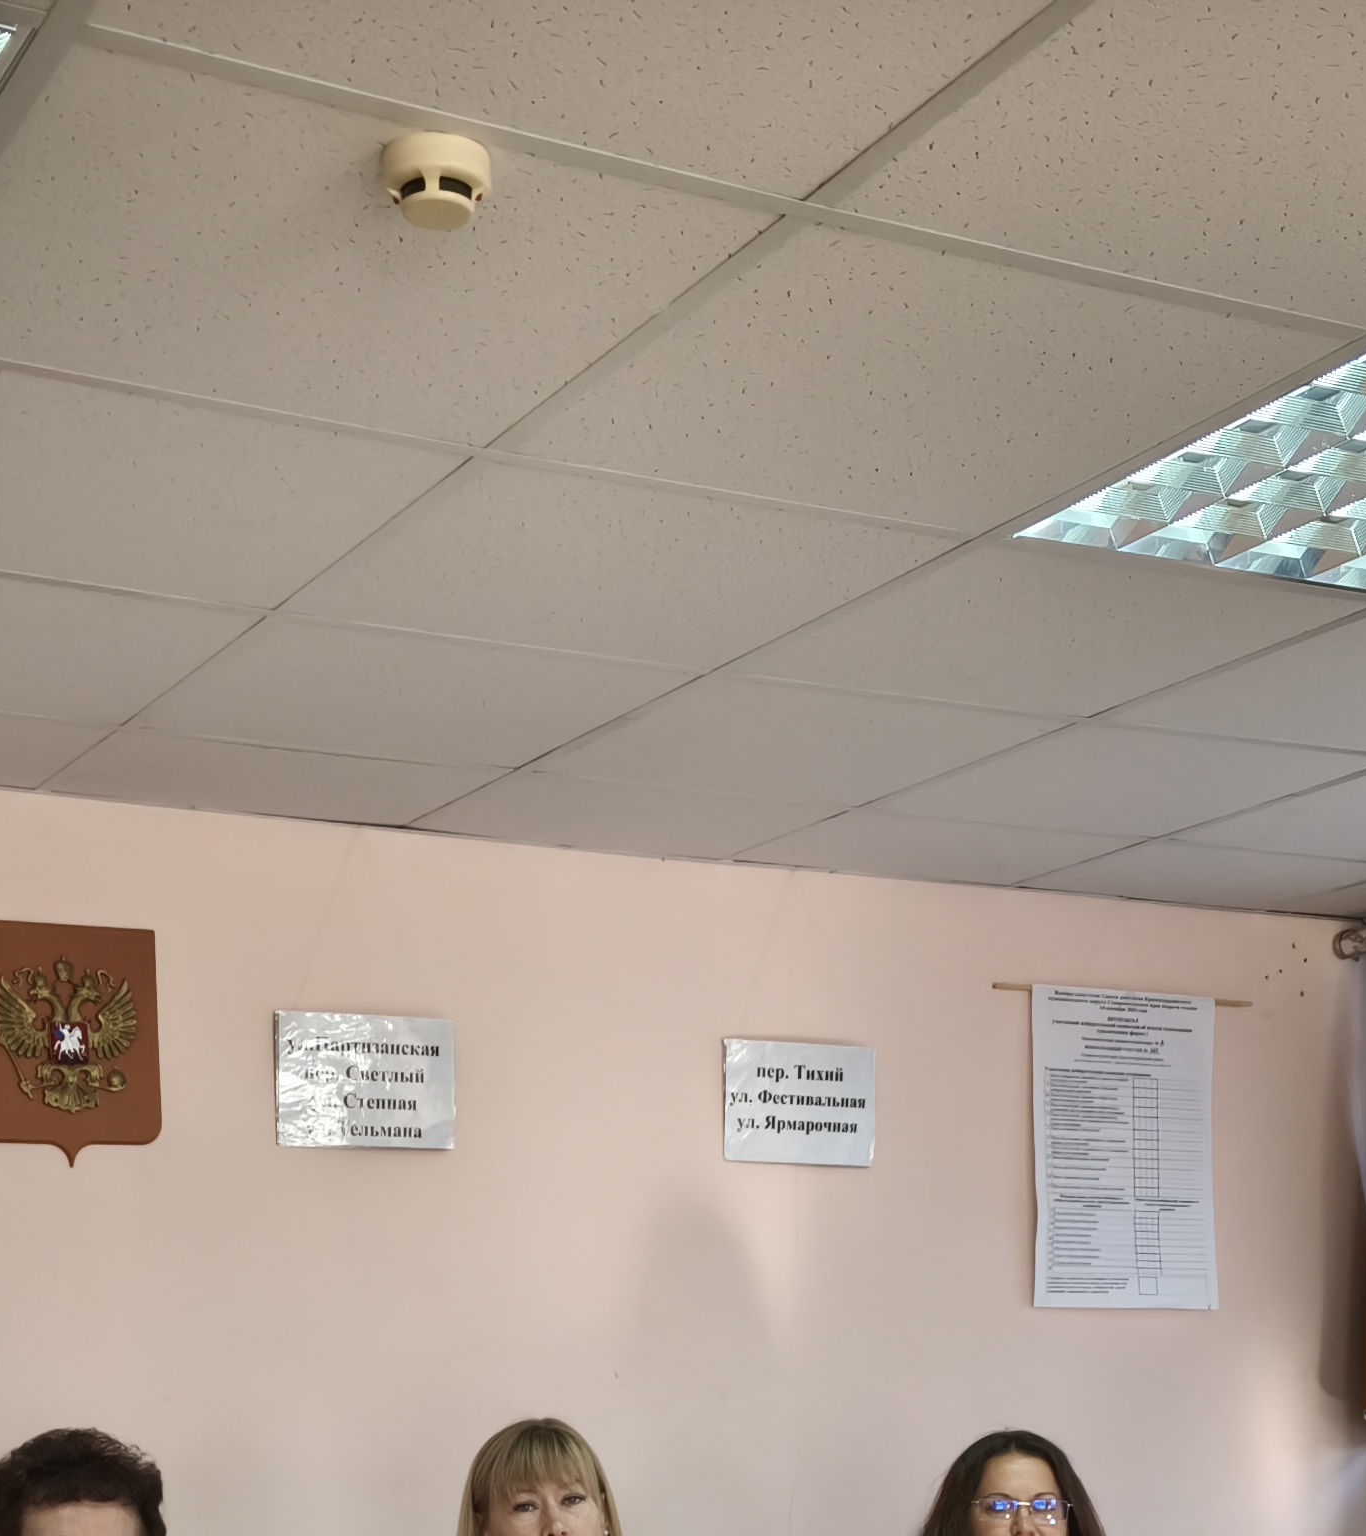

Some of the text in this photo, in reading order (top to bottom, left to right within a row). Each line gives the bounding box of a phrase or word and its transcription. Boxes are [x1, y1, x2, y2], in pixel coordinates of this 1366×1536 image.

[345, 1064, 425, 1084] Светлый
[756, 1064, 845, 1083] пер. Тихий
[343, 1092, 418, 1112] Степная
[729, 1089, 867, 1110] ул. Фестивальная
[736, 1115, 858, 1136] ул. Ярмарочная
